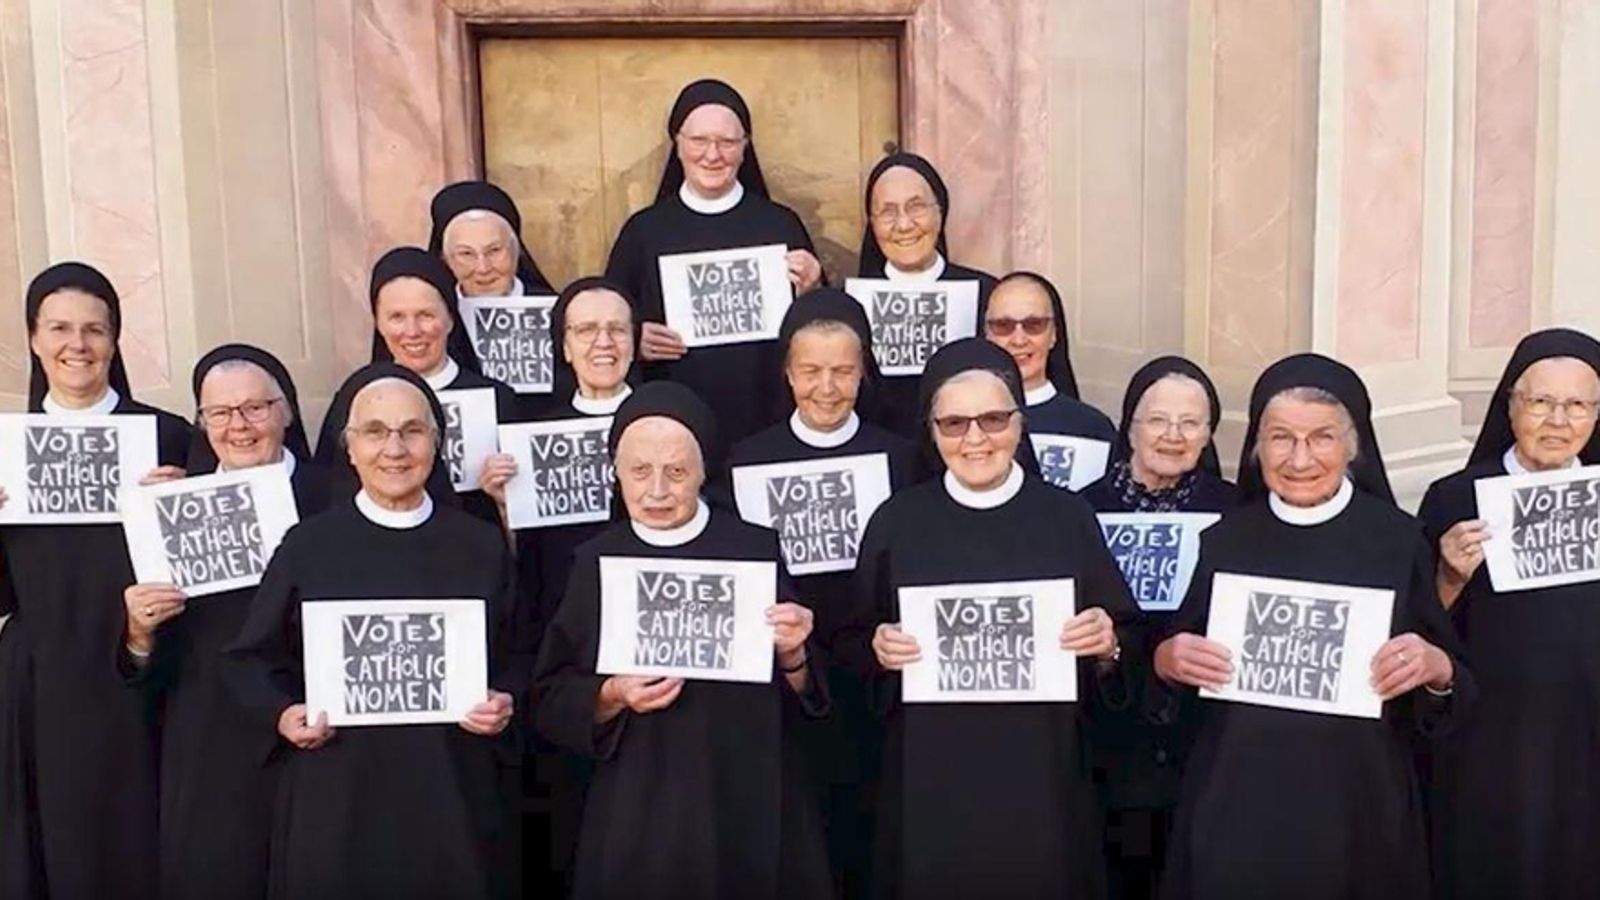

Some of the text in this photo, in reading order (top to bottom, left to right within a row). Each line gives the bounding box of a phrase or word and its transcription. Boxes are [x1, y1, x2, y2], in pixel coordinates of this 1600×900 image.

[687, 260, 758, 290] VOTES
[691, 291, 763, 315] CATHOLIC
[873, 292, 946, 317] VOTES
[475, 308, 551, 332] VOTES
[693, 312, 764, 337] WOMEN
[872, 323, 947, 346] CATHOLIC
[475, 339, 553, 359] CATHOLIC
[871, 343, 939, 367] WOME
[27, 429, 118, 456] VOTES
[27, 463, 120, 486] CATHOLIC
[534, 464, 616, 490] CATHOLIC
[768, 471, 853, 507] VOTES
[28, 487, 120, 513] WOMEN
[156, 484, 252, 526] VOTES
[1513, 481, 1600, 518] VOTES
[163, 523, 263, 560] CATHOLIC
[1101, 525, 1179, 549] VOTES
[1511, 518, 1600, 550] CATHOLIC
[168, 550, 266, 587] WOMEN
[1115, 556, 1178, 577] THOLIC
[1513, 543, 1600, 579] WOMEN
[637, 573, 735, 602] VOTES
[637, 610, 735, 639] CATHOLIC
[936, 597, 1033, 628] VOTES
[1249, 593, 1349, 631] VOTES
[343, 615, 444, 648] VOTES
[635, 638, 735, 668] WOMEN
[938, 634, 1034, 661] CATHOLIC
[1241, 634, 1343, 669] CATHOLIC
[344, 655, 446, 682] CATHOLIC
[938, 661, 1035, 690] WOMEN
[1238, 661, 1340, 702] WOMEN
[345, 682, 446, 714] WOMEN
